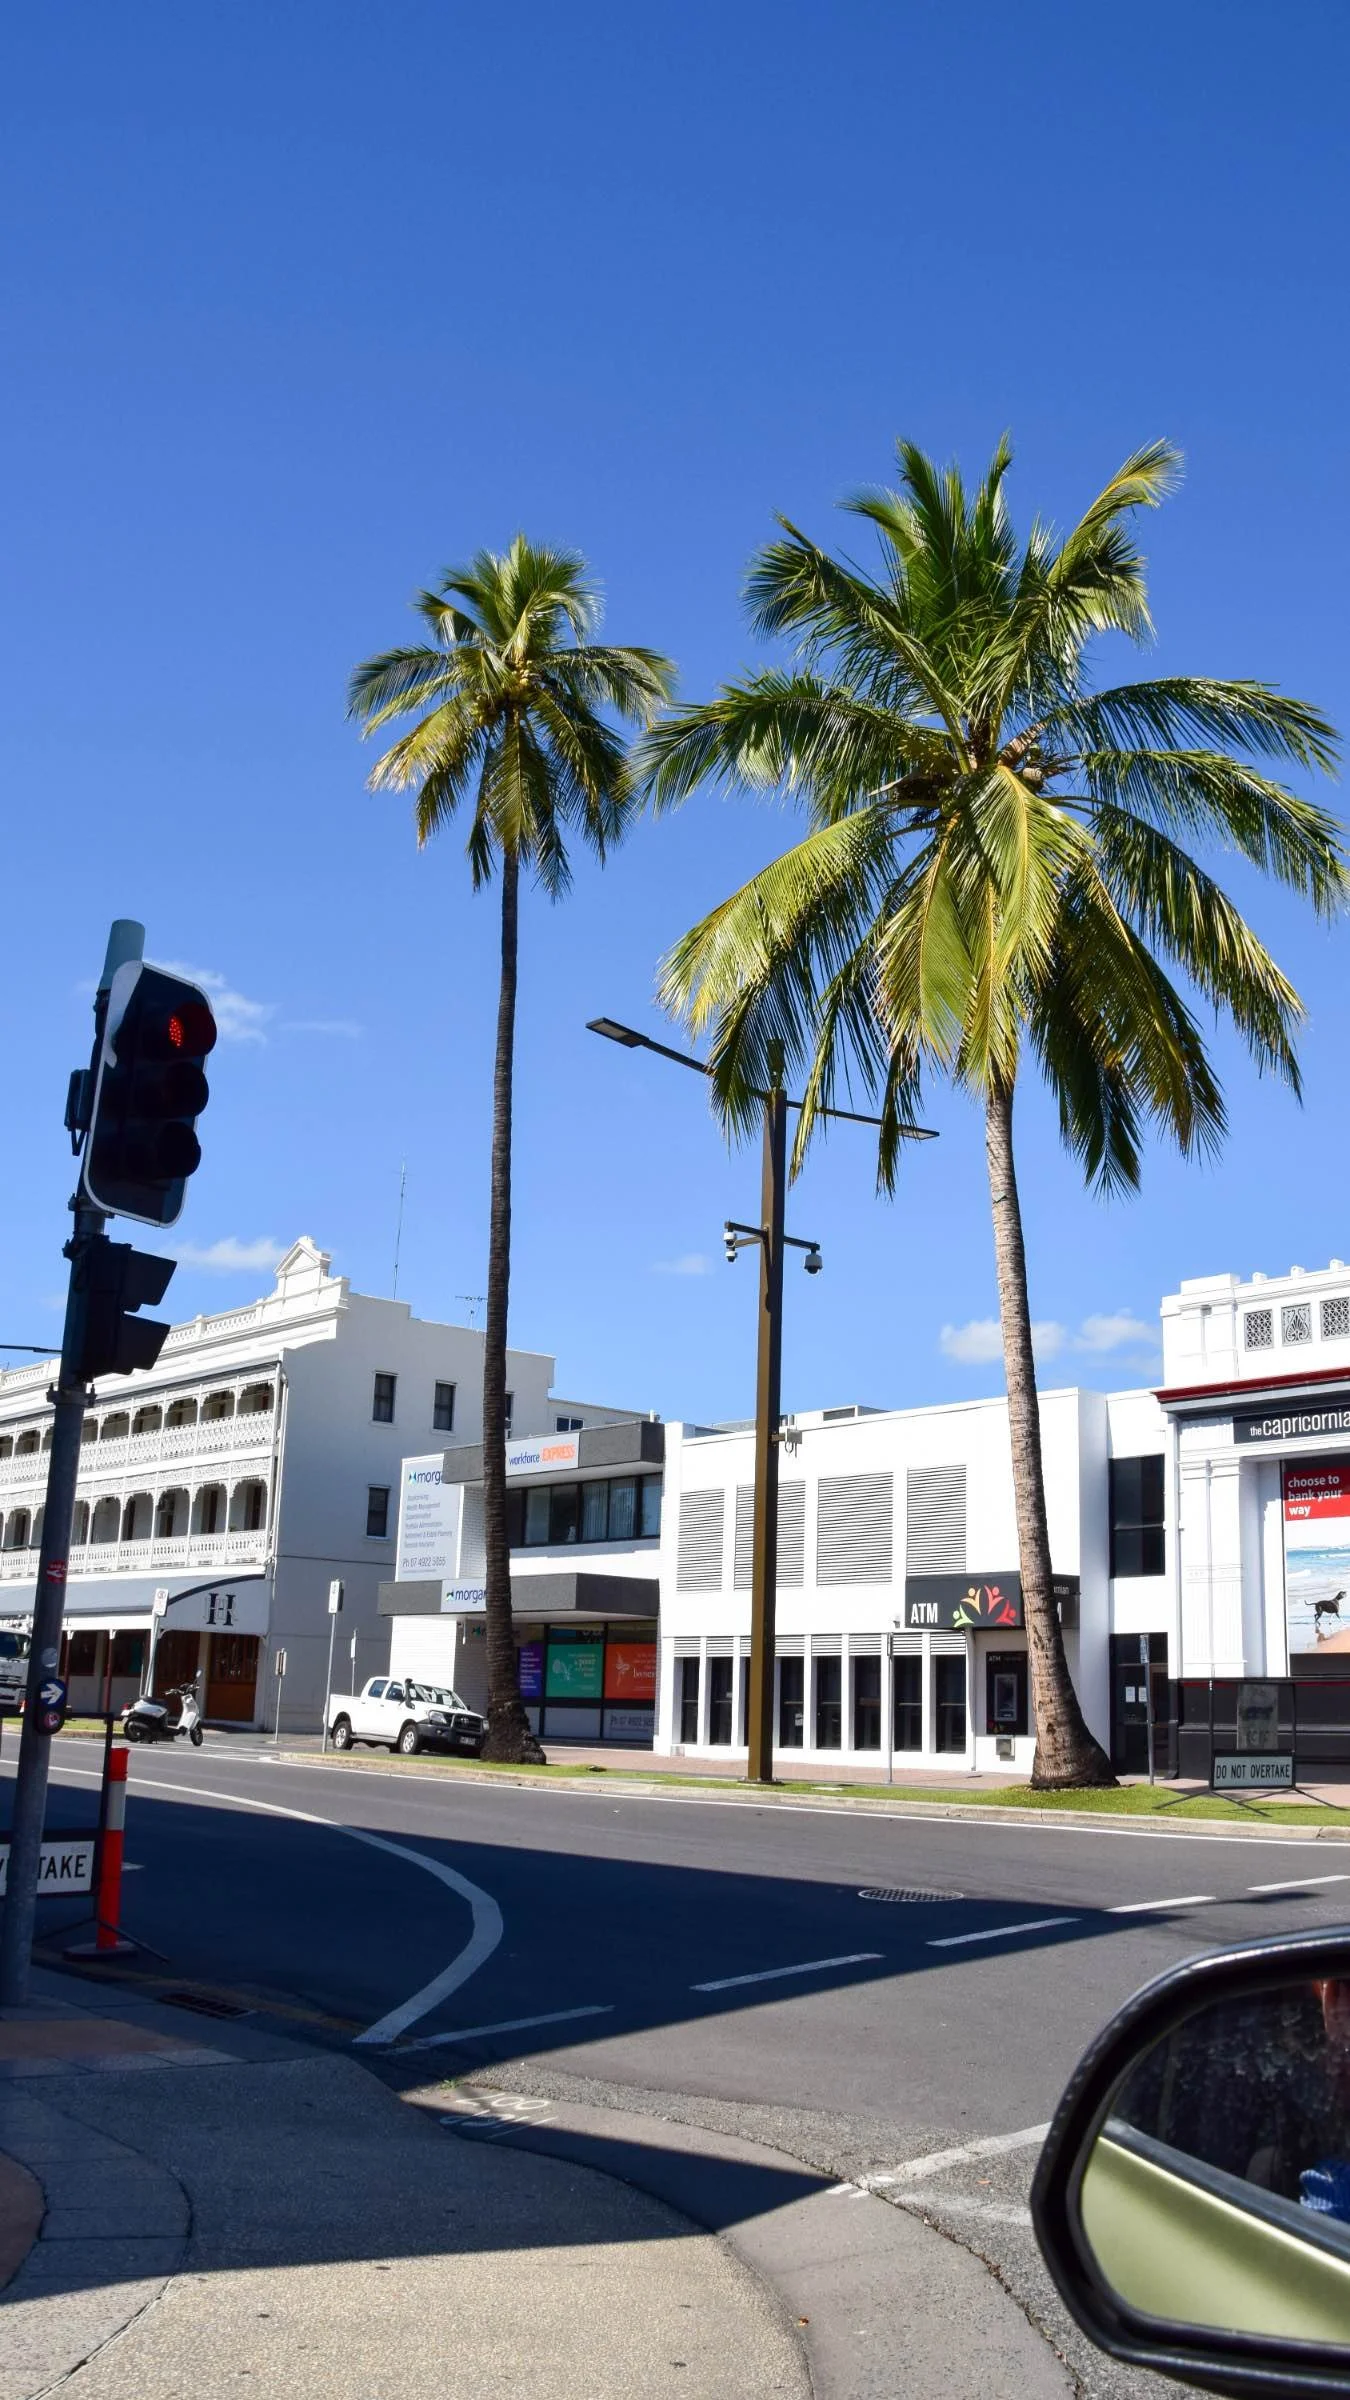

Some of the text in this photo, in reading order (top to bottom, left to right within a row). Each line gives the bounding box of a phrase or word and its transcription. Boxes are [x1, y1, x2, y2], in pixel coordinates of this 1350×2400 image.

[1250, 1425, 1262, 1436] the
[509, 1444, 576, 1466] workforce EXPRESS
[1288, 1475, 1340, 1488] choose to
[1288, 1489, 1342, 1503] bank your
[1289, 1505, 1311, 1517] way
[911, 1603, 938, 1624] ATM
[1216, 1764, 1290, 1779] DO NOT OVERTAKE
